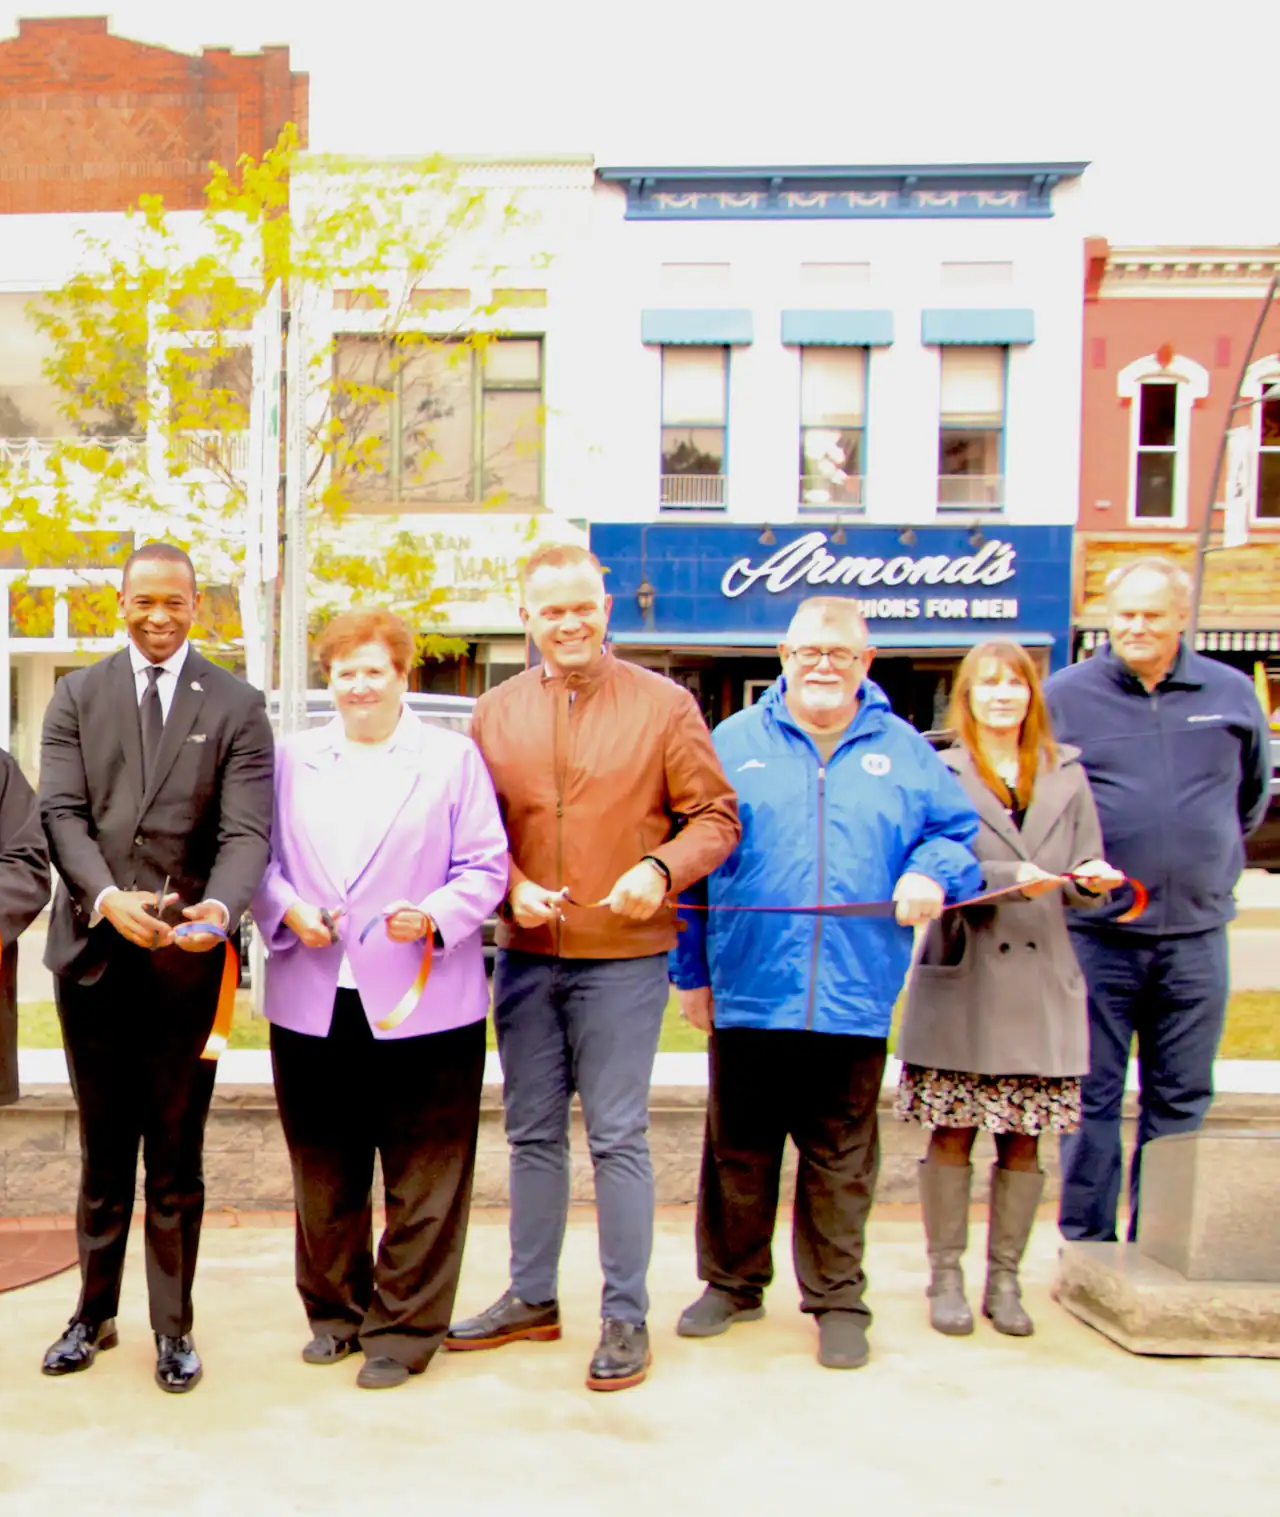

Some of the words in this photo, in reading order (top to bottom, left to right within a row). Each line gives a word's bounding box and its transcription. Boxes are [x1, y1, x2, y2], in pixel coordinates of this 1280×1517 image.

[721, 531, 1016, 598] Armond's
[857, 598, 920, 618] HIONS
[925, 598, 968, 618] FOR
[970, 598, 1018, 618] MEN
